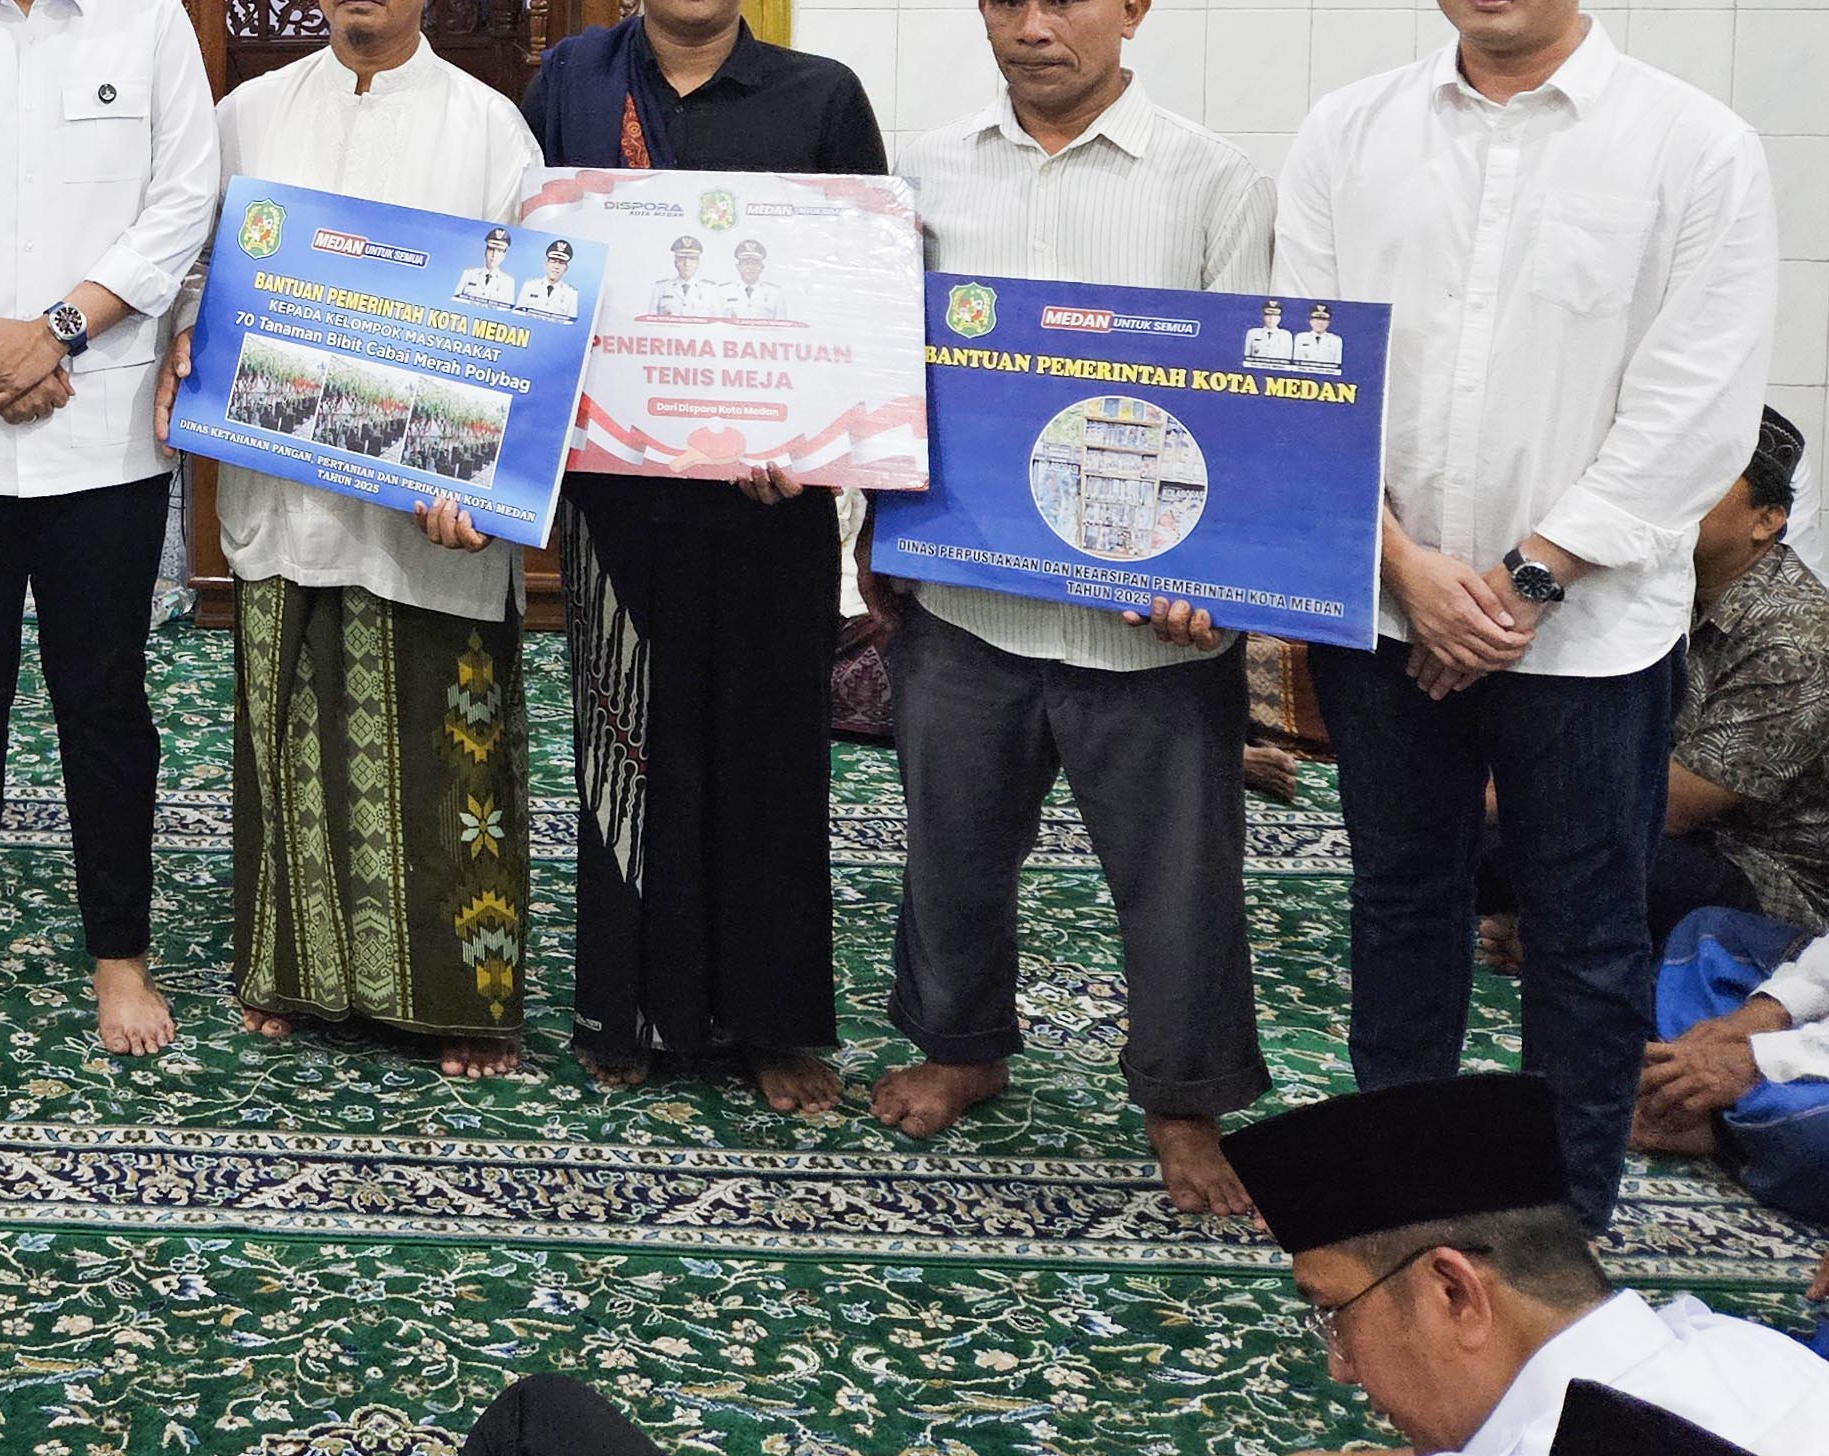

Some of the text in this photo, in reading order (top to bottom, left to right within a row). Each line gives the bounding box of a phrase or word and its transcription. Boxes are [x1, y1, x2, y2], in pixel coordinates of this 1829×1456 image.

[603, 201, 684, 212] DISPORA
[747, 204, 792, 216] MEDAN
[314, 232, 425, 265] MEDAN UNTUK SEMUA
[253, 272, 324, 303] BANTUAN
[326, 288, 423, 324] PEMERINTAH
[429, 308, 468, 334] KOTA
[473, 319, 531, 348] MEDAN
[1044, 310, 1194, 334] MEDAN UNTUK SEMUA
[269, 299, 502, 363] KEPADA KELOMPOK MASYARAKAT
[235, 311, 531, 394] 70 Tanaman Bibit Cabai Merah Polybag
[723, 340, 853, 364] BANTUAN
[642, 365, 793, 390] TENIS MEJA
[1036, 355, 1187, 388] PEMERINTAH
[1192, 370, 1259, 395] KOTA
[1264, 377, 1358, 404] MEDAN
[657, 403, 677, 411] Dari
[719, 405, 742, 414] Kota
[744, 407, 779, 416] Medan
[179, 419, 536, 523] DINAS KETAHANAN PANGAN, PERTANIAN DAN PERIKANAN KOTA MEDAN
[317, 468, 380, 494] TAHUN 2025
[898, 539, 1344, 618] DINAS PERPUSTAKAAN DAN KEARSIPAN PEMERINTAH KOTA MEDAN
[1066, 581, 1151, 606] TAHUN 2025
